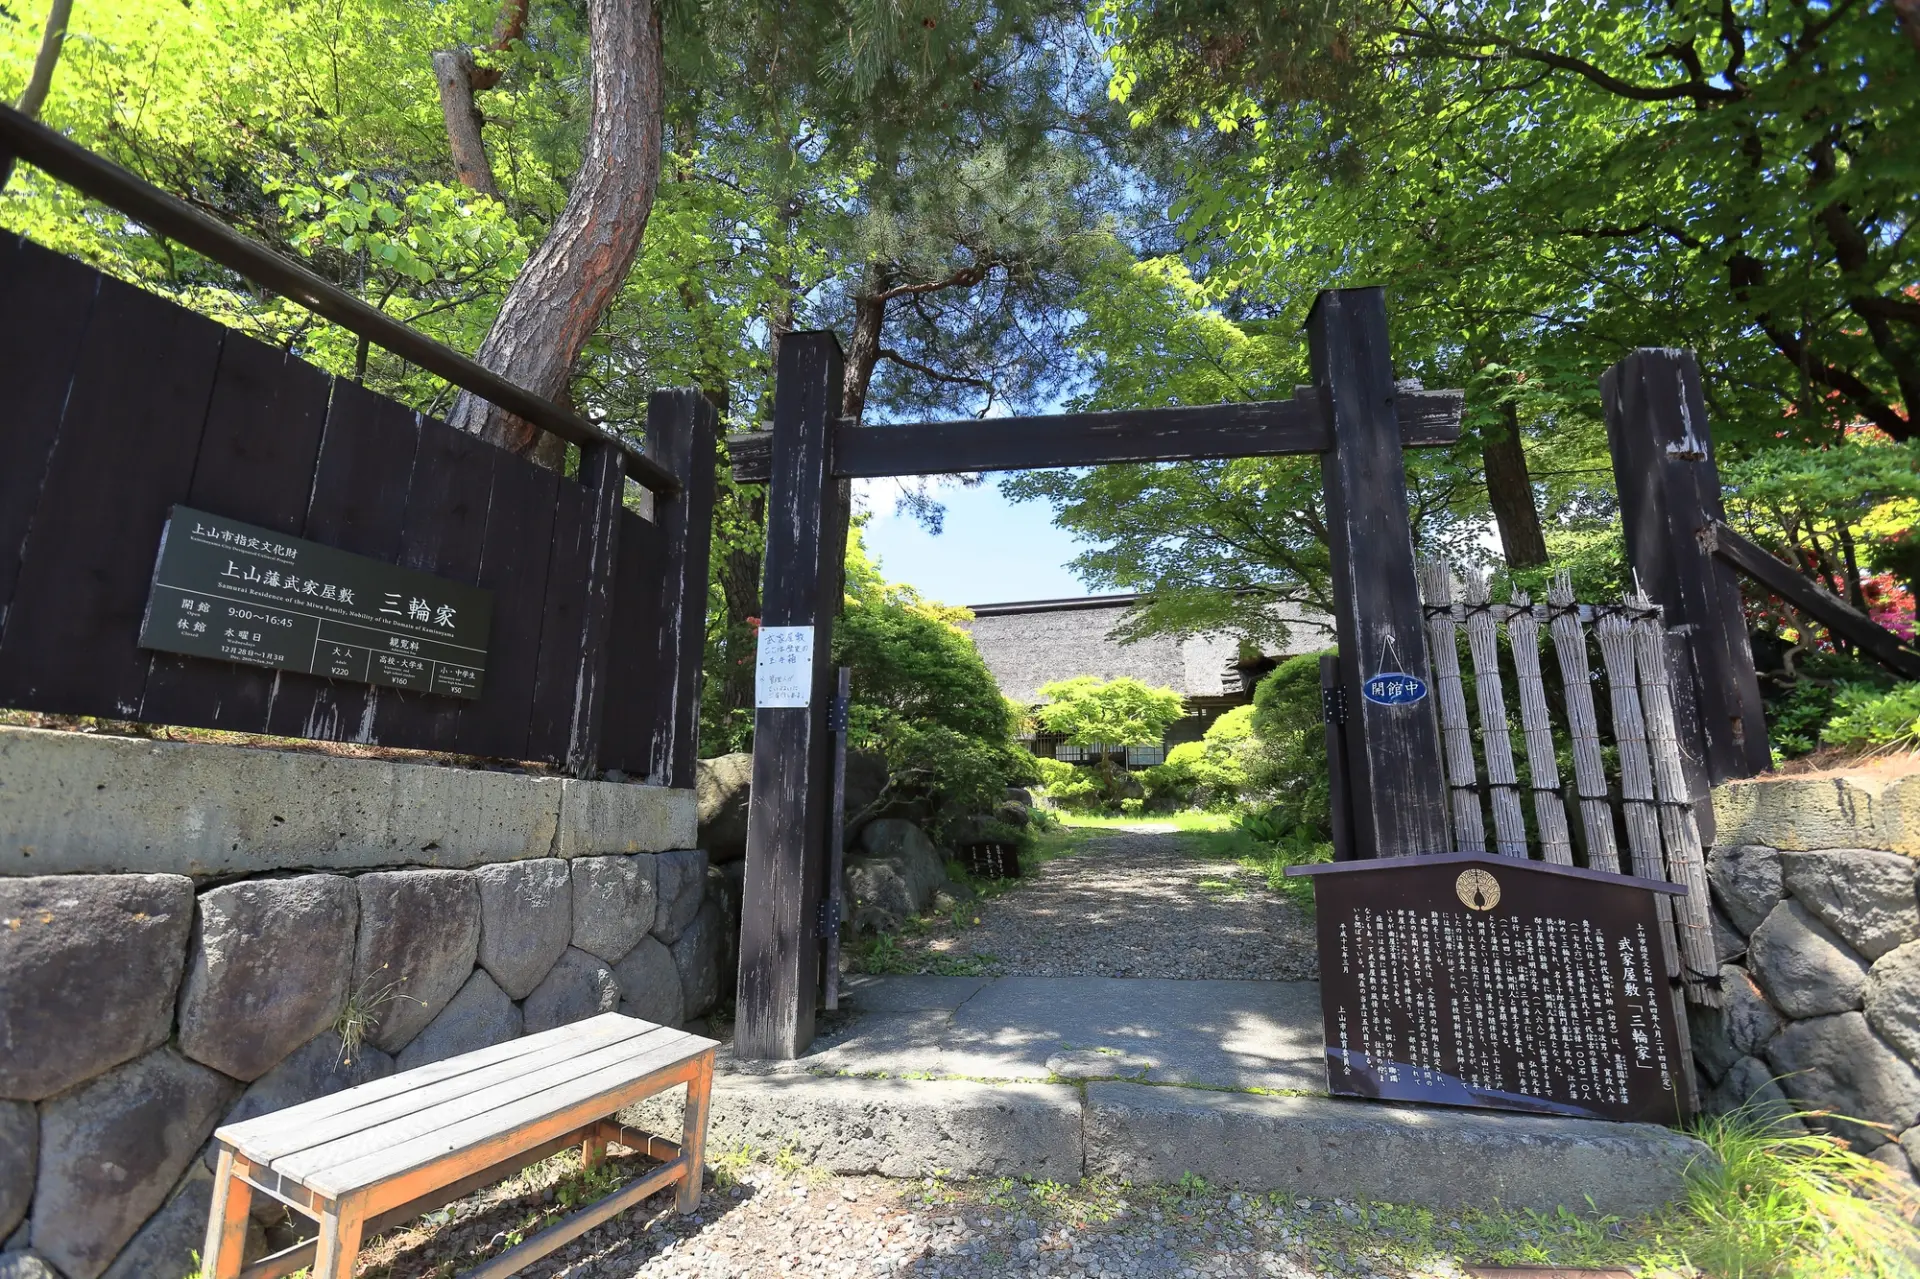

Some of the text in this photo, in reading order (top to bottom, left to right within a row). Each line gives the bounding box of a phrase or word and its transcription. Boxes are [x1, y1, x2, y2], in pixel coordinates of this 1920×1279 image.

[190, 535, 221, 547] Kaminoyama
[232, 546, 257, 556] Designated
[257, 552, 276, 560] Cultural
[192, 522, 298, 559] 上山市指定文化財
[220, 559, 456, 628] 上山藩武家屋敷 三輪家
[181, 599, 211, 613] 開館
[217, 581, 247, 593] Samurai
[249, 588, 283, 601] Residence
[294, 598, 305, 606] the
[306, 601, 324, 610] Miwa
[324, 605, 348, 616] Family,
[349, 610, 374, 622] Nobility
[393, 620, 414, 630] Domain
[422, 626, 455, 638] Kaminoyama
[177, 618, 207, 633] 休館
[181, 630, 199, 638] Closed
[224, 628, 261, 642] 水曜日
[765, 632, 805, 644] 武家屋敷
[389, 637, 419, 651] 観覧料
[332, 646, 352, 658] 大人
[380, 655, 424, 670] 高校・大学生
[331, 667, 349, 676] ¥220
[391, 676, 408, 685] ¥160
[1372, 680, 1418, 696] 開館中
[451, 686, 461, 694] ¥50
[1431, 911, 1443, 966] 勤務をしている。
[1338, 922, 1351, 1076] 平成十七年三月 上山市教育委員会
[1618, 936, 1653, 1069] 武家屋敷「三輪家」
